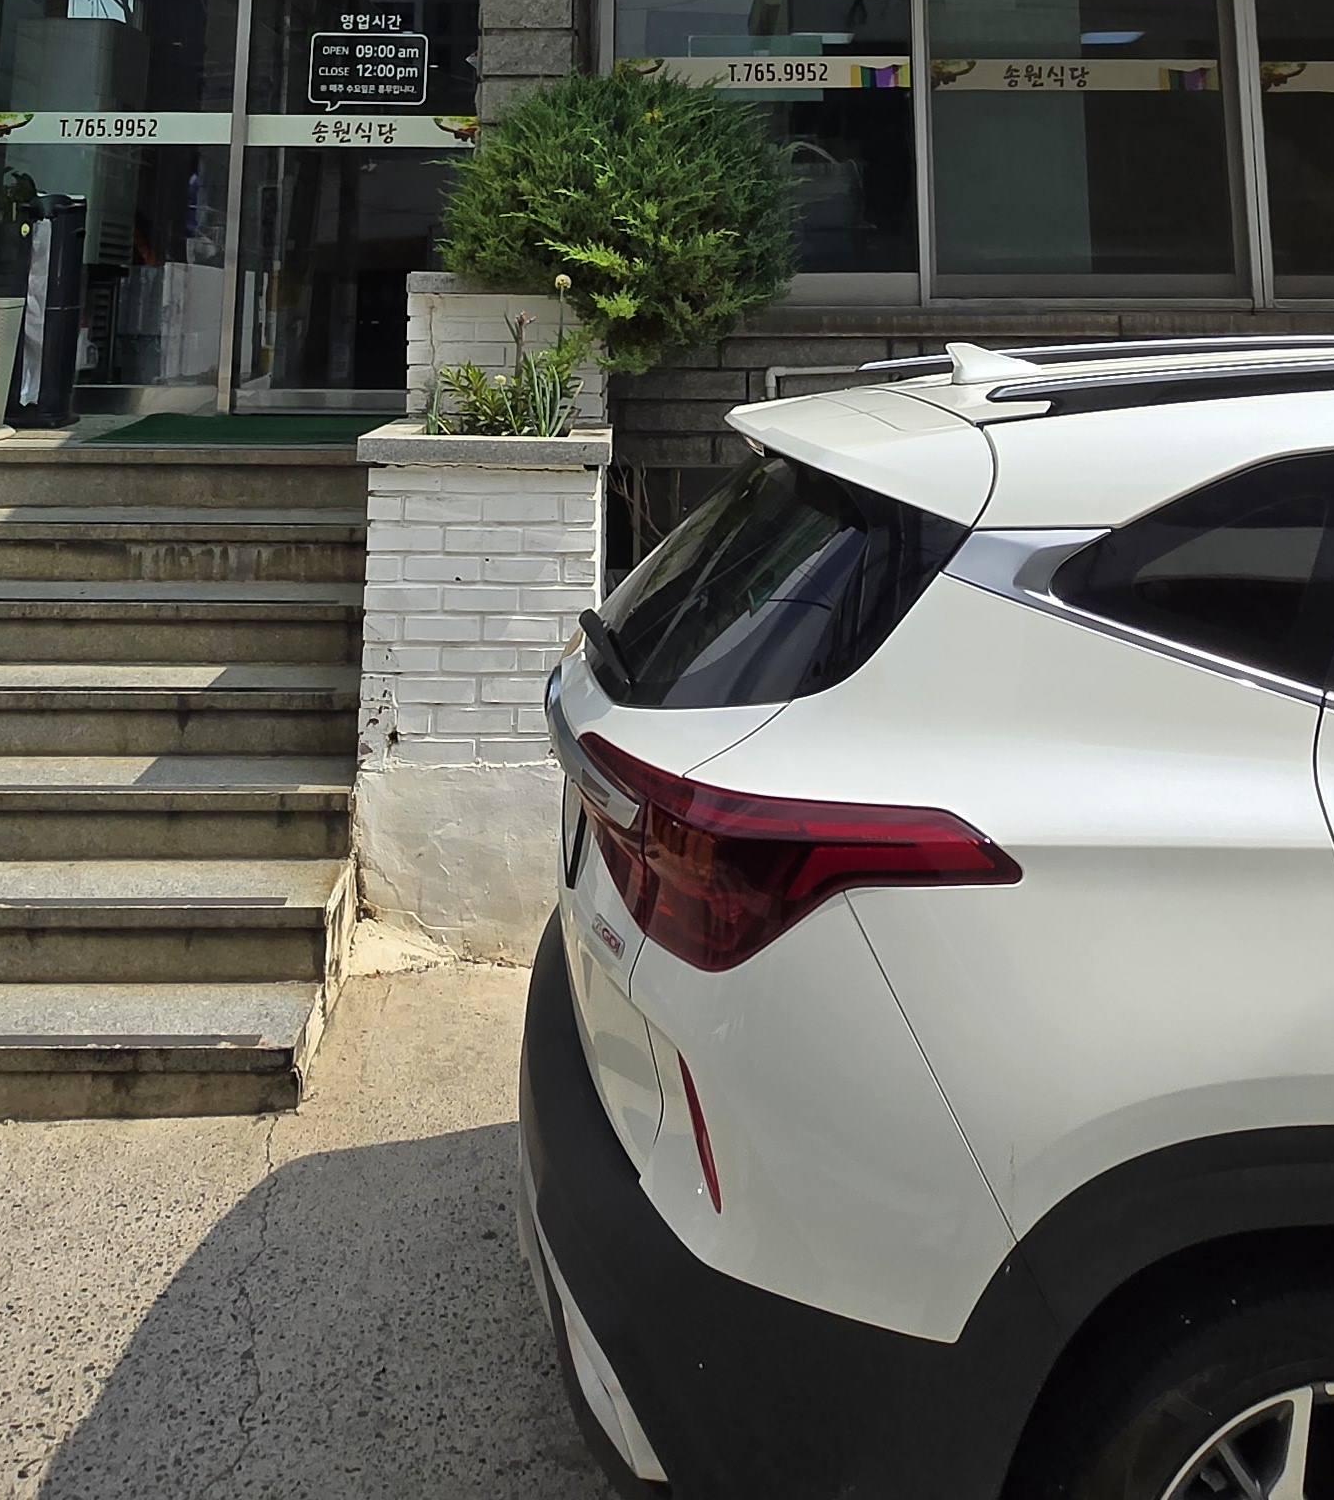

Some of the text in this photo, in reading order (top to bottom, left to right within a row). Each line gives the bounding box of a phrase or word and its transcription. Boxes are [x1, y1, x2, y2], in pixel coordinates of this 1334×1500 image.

[340, 14, 402, 30] 영업시간
[322, 45, 419, 58] OPEN 09:00 am
[318, 64, 418, 80] CLOSE 12:00 pm
[728, 62, 829, 83] T.765.9952
[1003, 65, 1090, 88] 송원식당
[59, 118, 158, 137] T.765.9952
[311, 120, 398, 144] 송원식당
